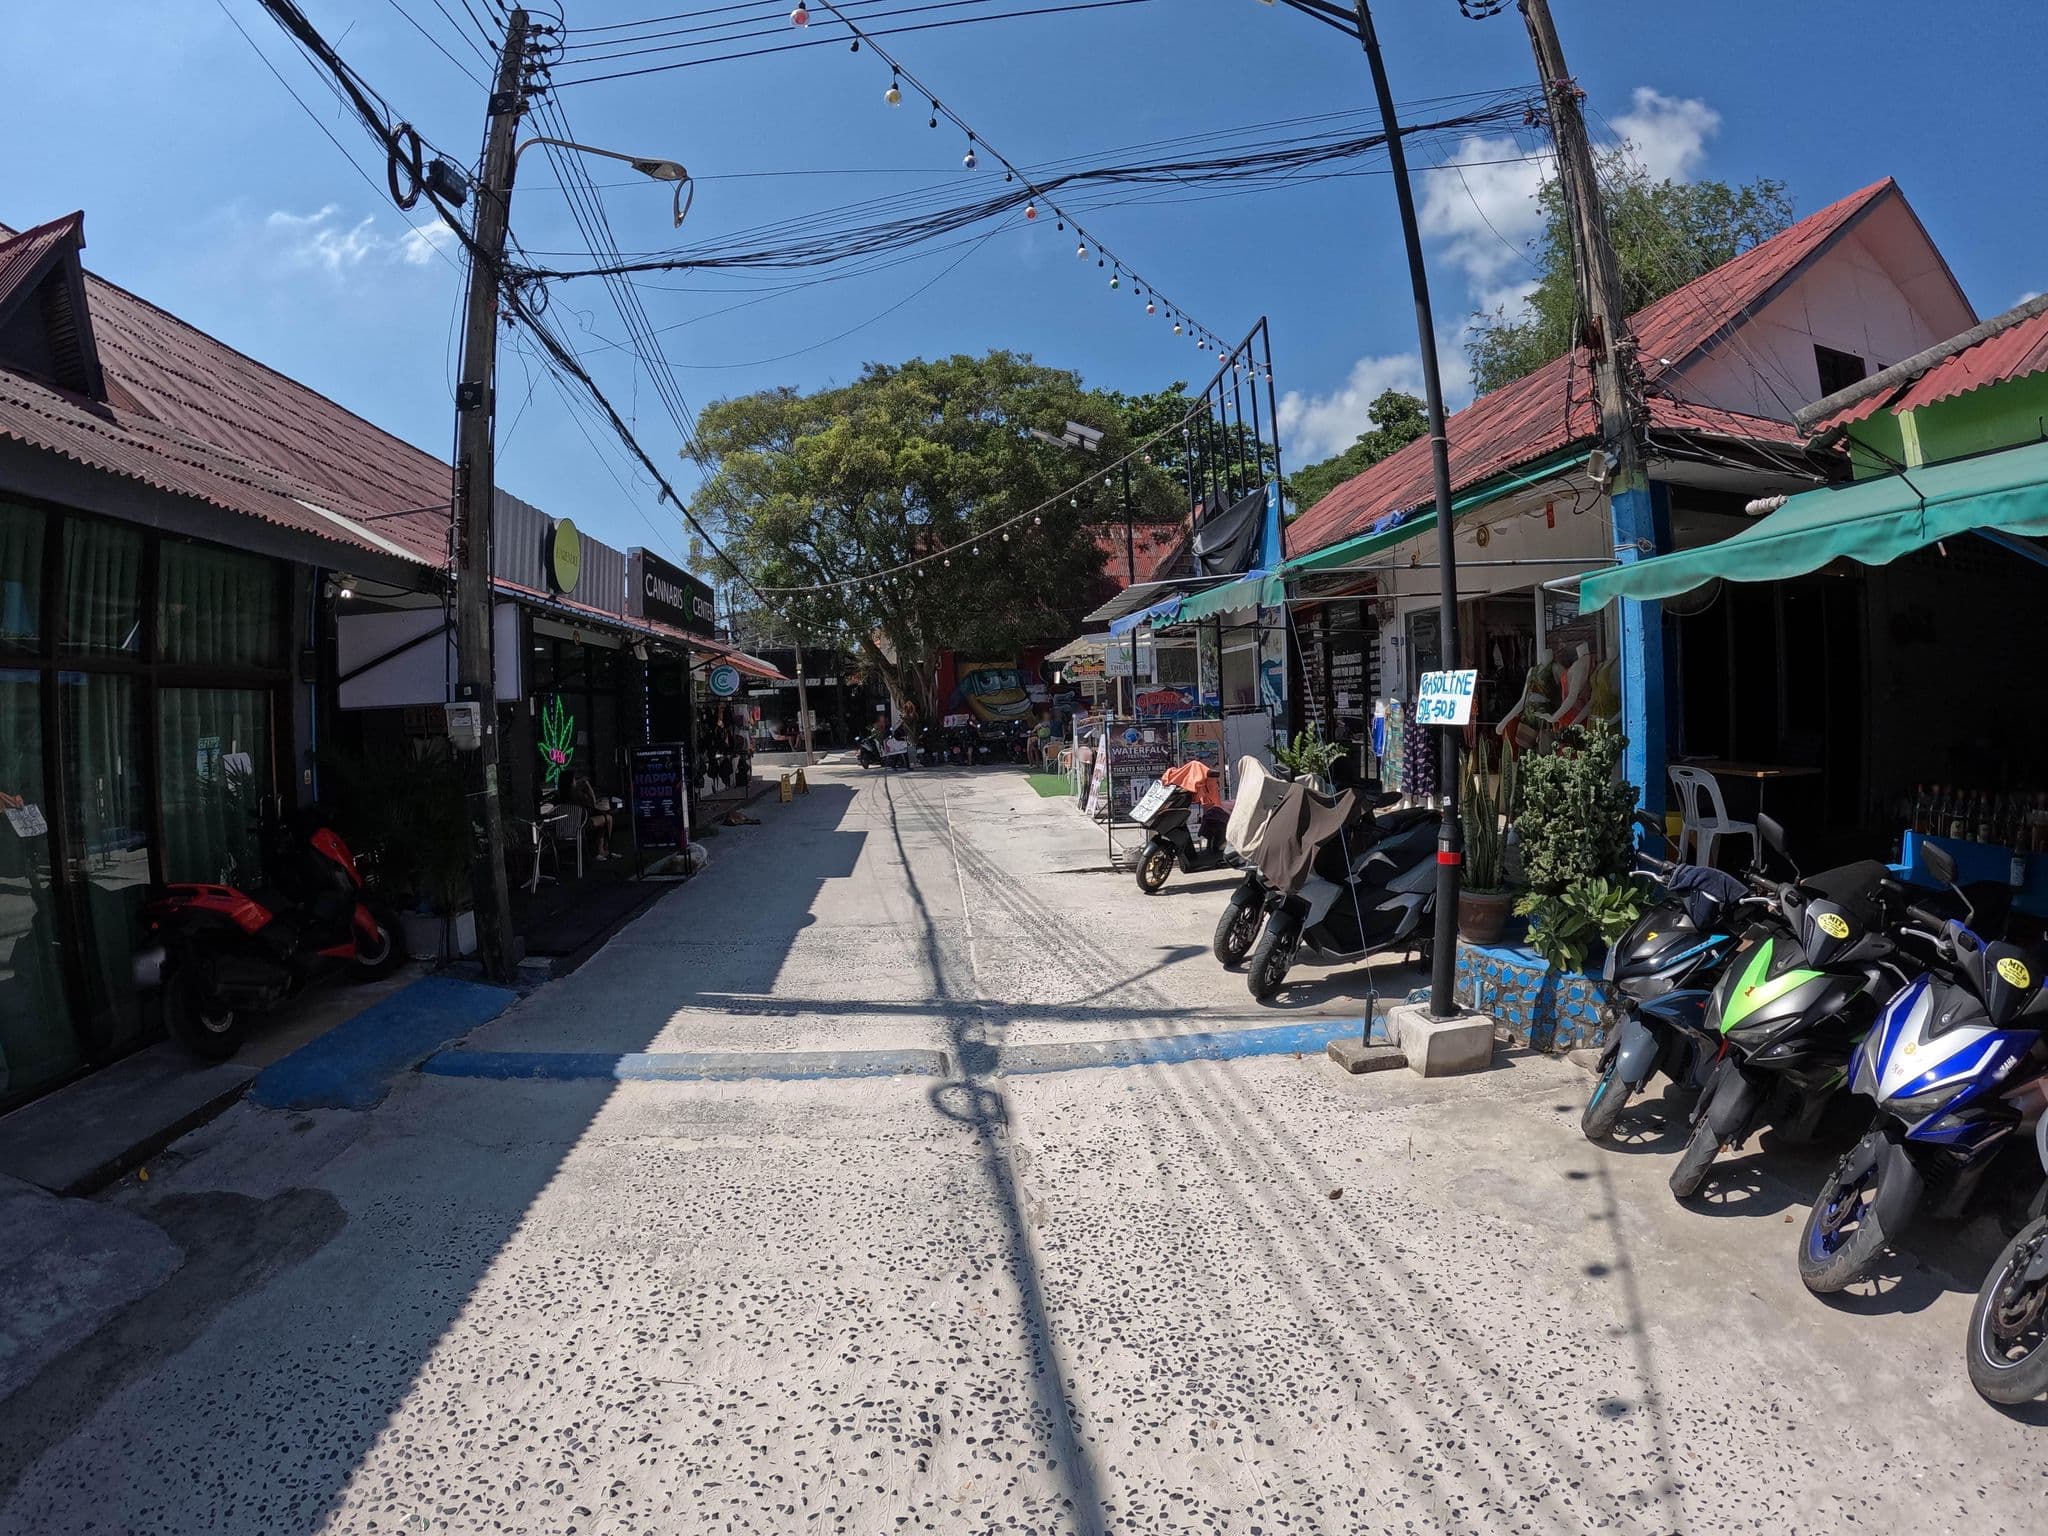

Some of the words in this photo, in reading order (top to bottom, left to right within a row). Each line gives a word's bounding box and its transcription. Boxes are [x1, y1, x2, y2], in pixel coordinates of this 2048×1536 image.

[645, 573, 683, 610] CANNABIS
[692, 596, 714, 623] CENTER
[1422, 673, 1474, 696] GASOLINE
[549, 747, 566, 765] OPEN
[1111, 745, 1169, 756] WATERFALL
